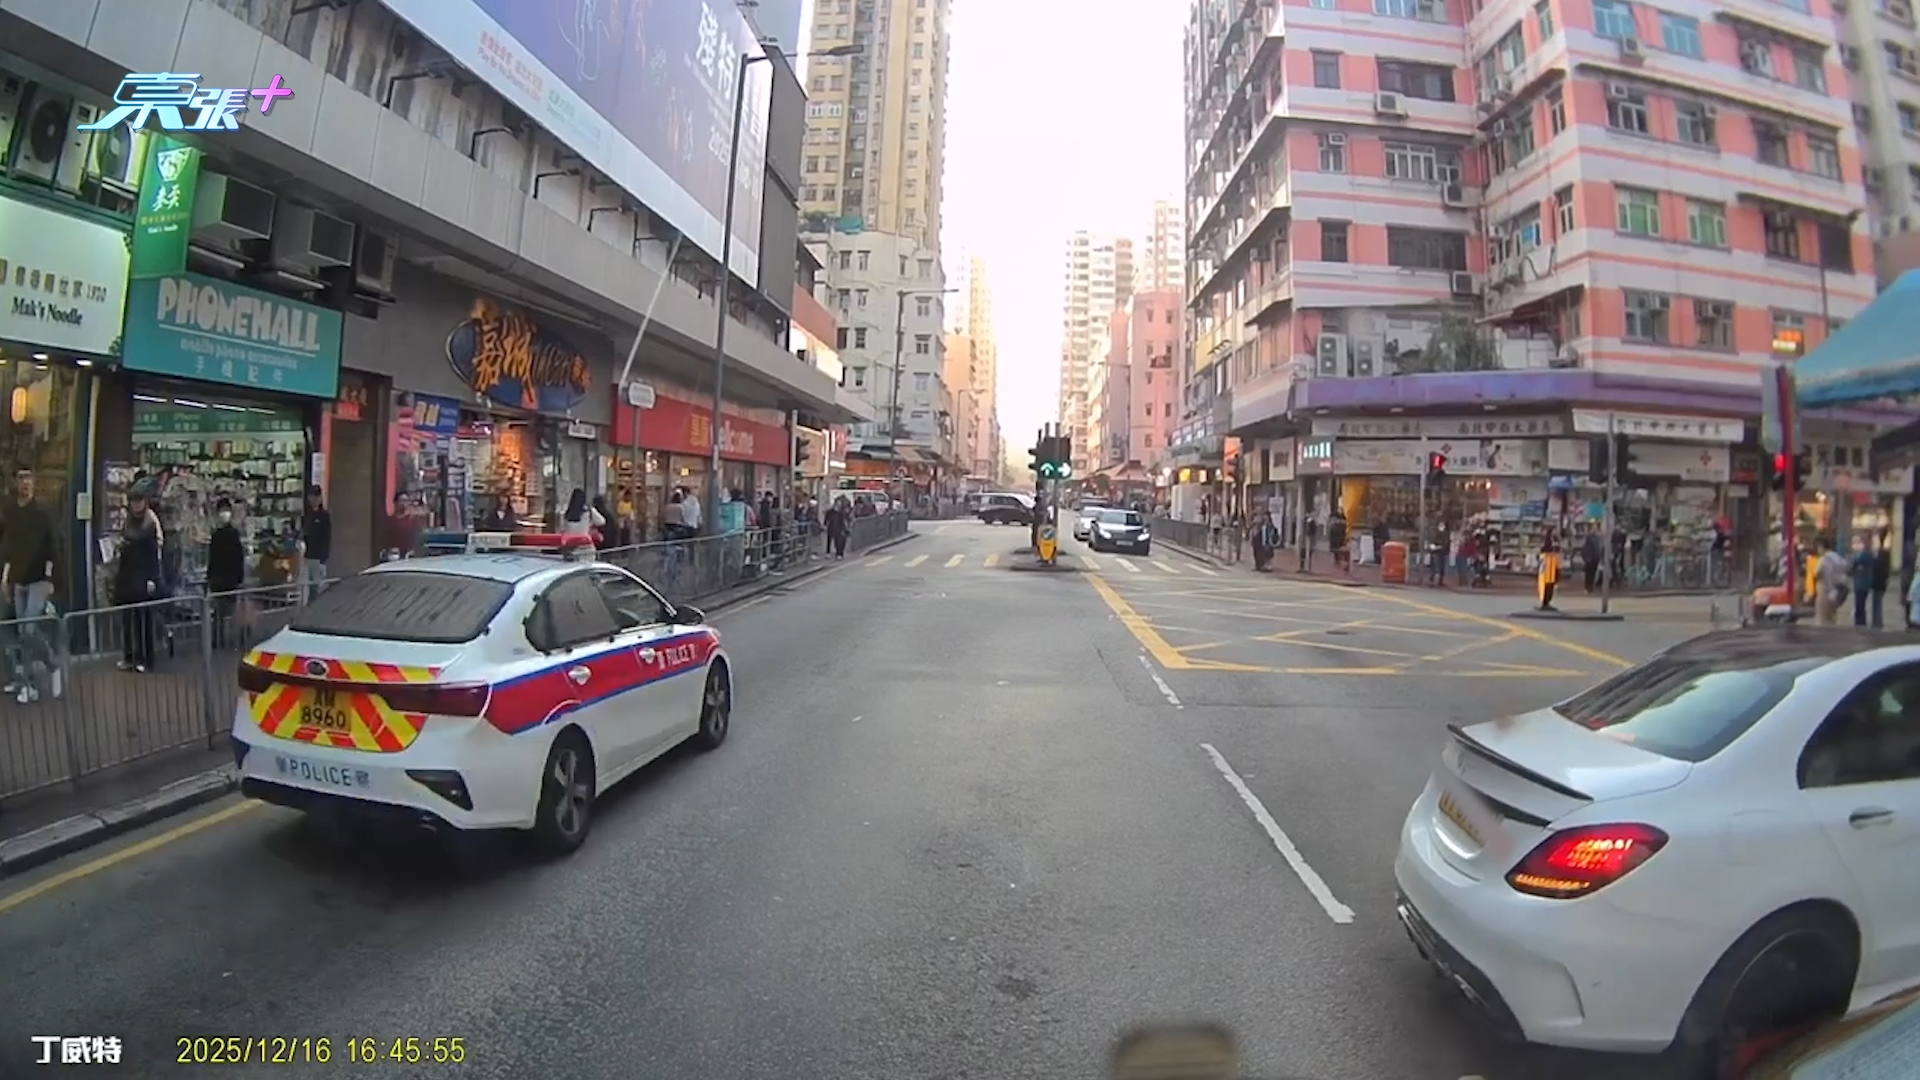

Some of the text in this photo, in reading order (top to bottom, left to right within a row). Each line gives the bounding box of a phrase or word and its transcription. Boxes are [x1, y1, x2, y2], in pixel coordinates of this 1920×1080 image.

[11, 296, 83, 326] Mak's Noodle
[301, 706, 347, 730] 8960
[289, 758, 353, 787] POLICE
